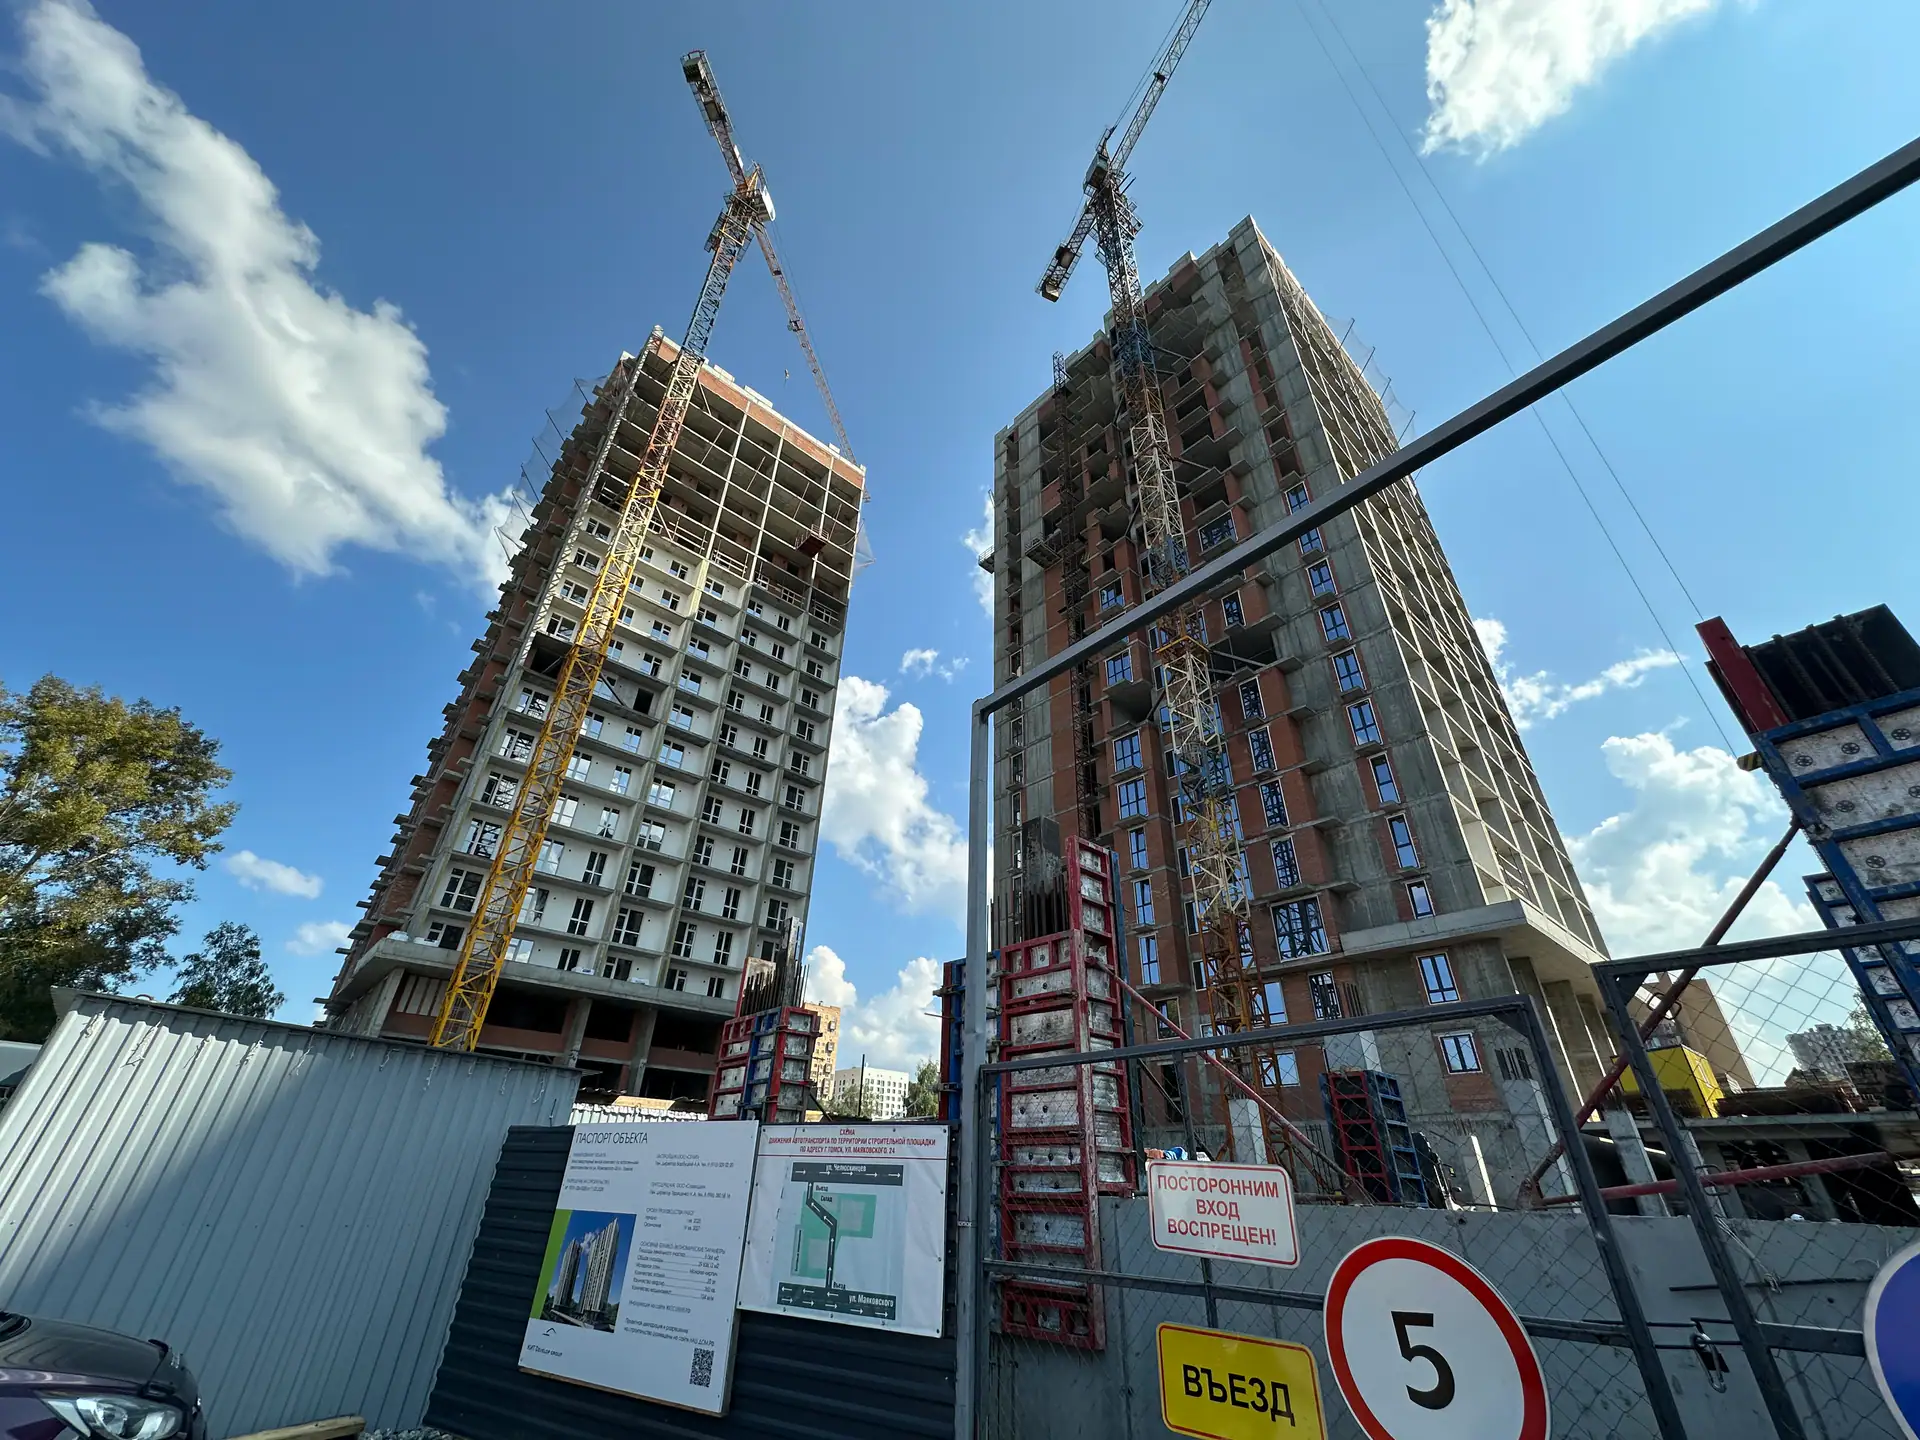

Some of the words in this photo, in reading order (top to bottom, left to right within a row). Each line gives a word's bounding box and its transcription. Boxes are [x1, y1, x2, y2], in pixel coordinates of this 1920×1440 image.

[576, 1132, 612, 1144] ПАСПОРТ
[612, 1132, 648, 1144] ОБЪЕКТА
[792, 1137, 830, 1145] АВТОТРАНСПОРТА
[868, 1137, 906, 1145] СТРОИТЕЛЬНОЙ
[1157, 1174, 1280, 1198] ПОСТОРОННИМ
[1196, 1198, 1241, 1222] ВХОД
[1167, 1217, 1277, 1247] ВОСПРЕЩЕН!
[849, 1295, 857, 1304] ул.
[857, 1294, 894, 1308] Маяковского
[1390, 1310, 1456, 1411] 5
[1182, 1364, 1296, 1427] ВЪЕЗД
